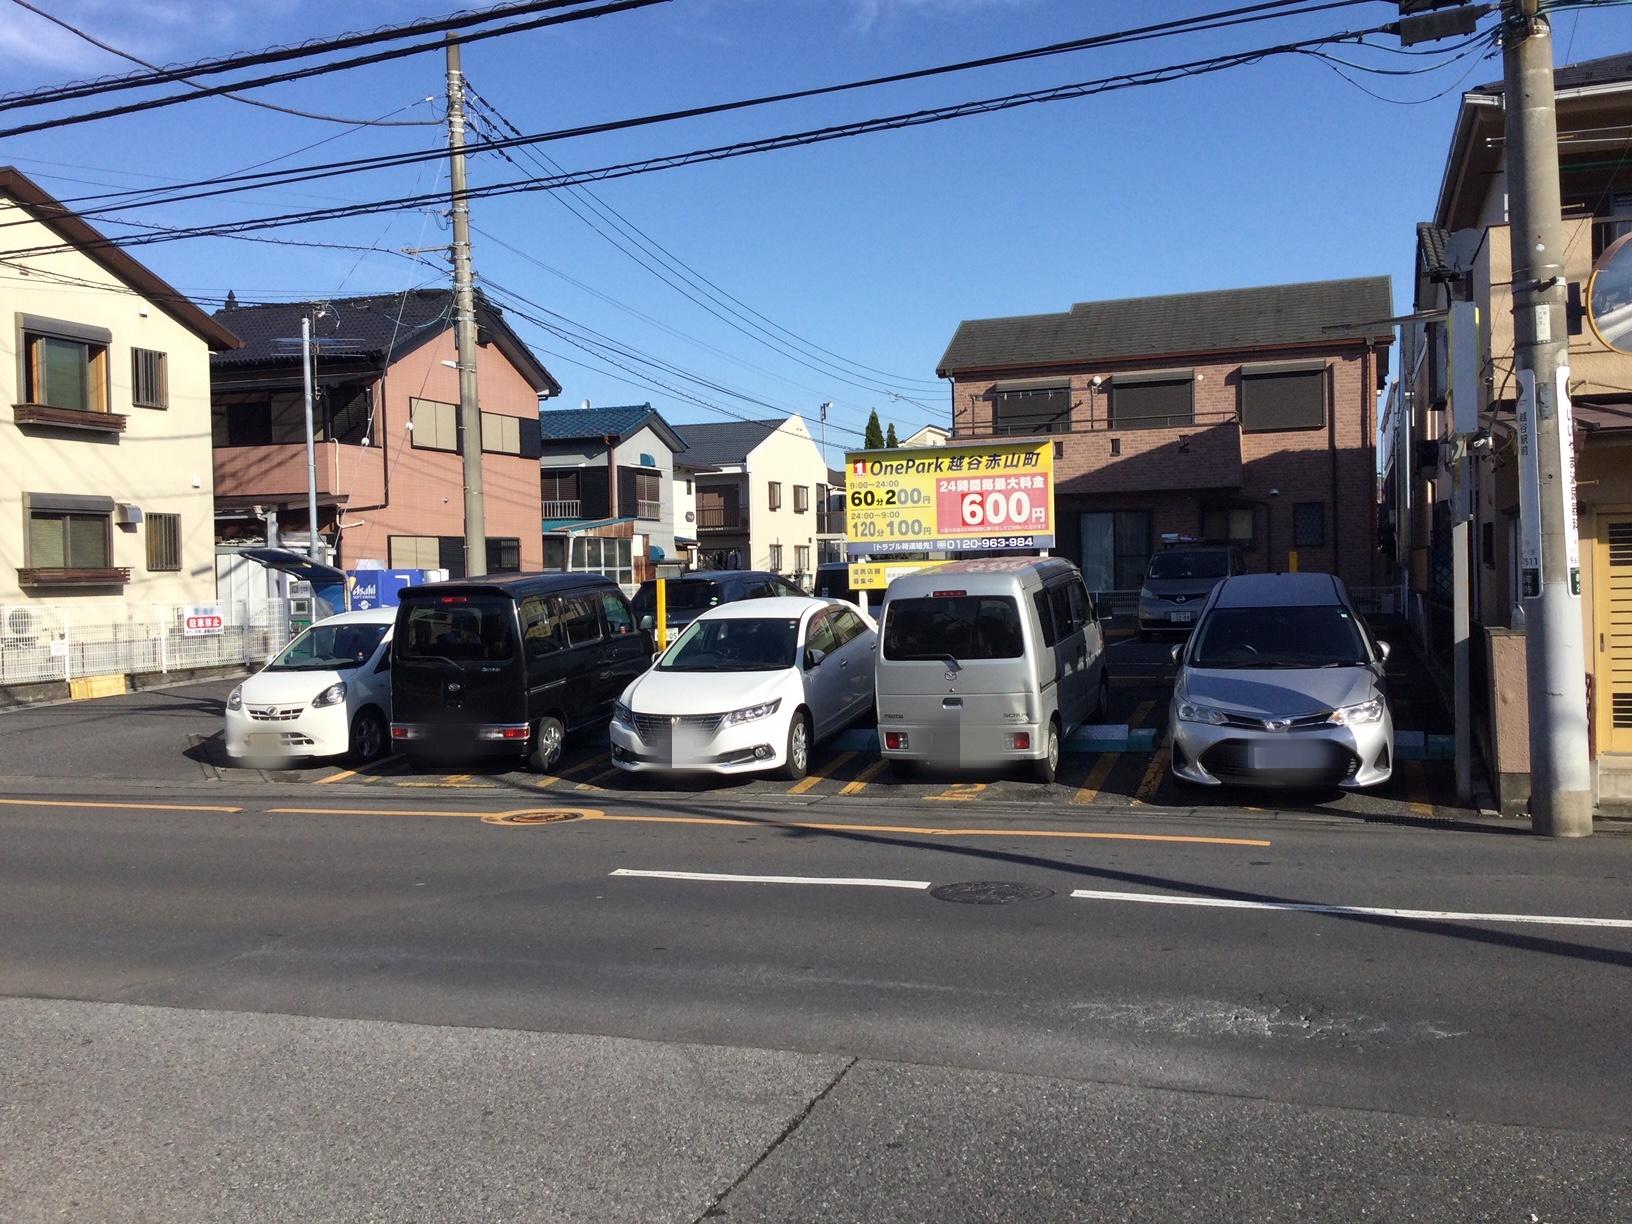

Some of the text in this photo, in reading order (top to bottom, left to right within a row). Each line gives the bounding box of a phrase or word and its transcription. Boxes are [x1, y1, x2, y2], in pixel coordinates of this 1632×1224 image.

[870, 457, 944, 476] OnePark
[947, 451, 1041, 471] 越谷赤山町
[939, 476, 1045, 492] 24時間毎最大料金
[947, 537, 1033, 549] 0120-963-984
[352, 584, 376, 596] Asahi
